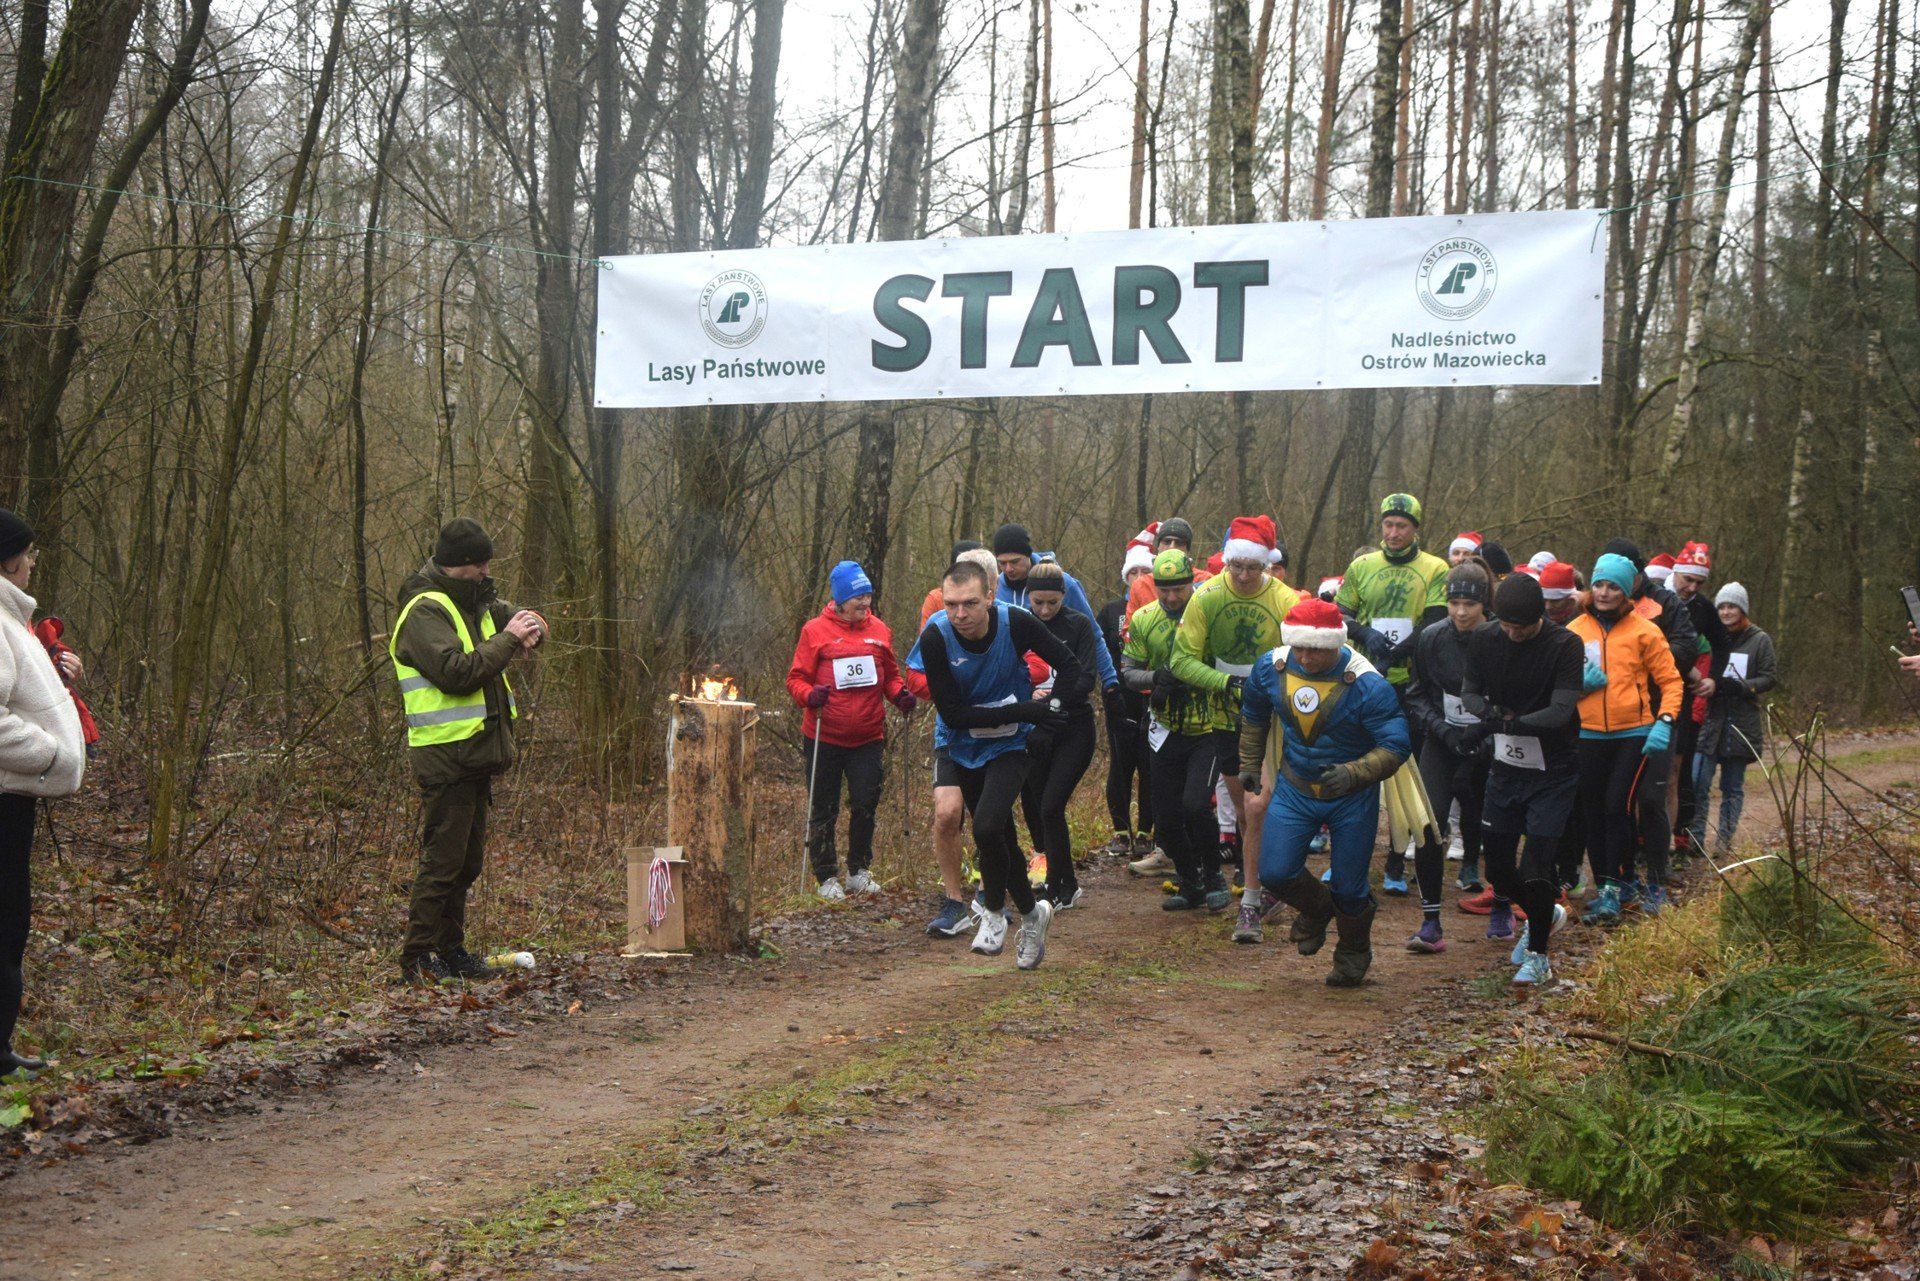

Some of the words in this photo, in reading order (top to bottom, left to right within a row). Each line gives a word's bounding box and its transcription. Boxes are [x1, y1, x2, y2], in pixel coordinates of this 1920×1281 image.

[1420, 250, 1438, 278] LASY
[701, 281, 717, 308] LASY
[871, 259, 1269, 373] START
[1391, 330, 1516, 348] Nadleśnictwo
[648, 361, 696, 385] Lasy
[703, 357, 826, 379] Państwowe
[1361, 353, 1427, 370] Ostrów
[1433, 350, 1546, 368] Mazowiecka
[846, 663, 863, 677] 36
[1505, 744, 1525, 759] 25
